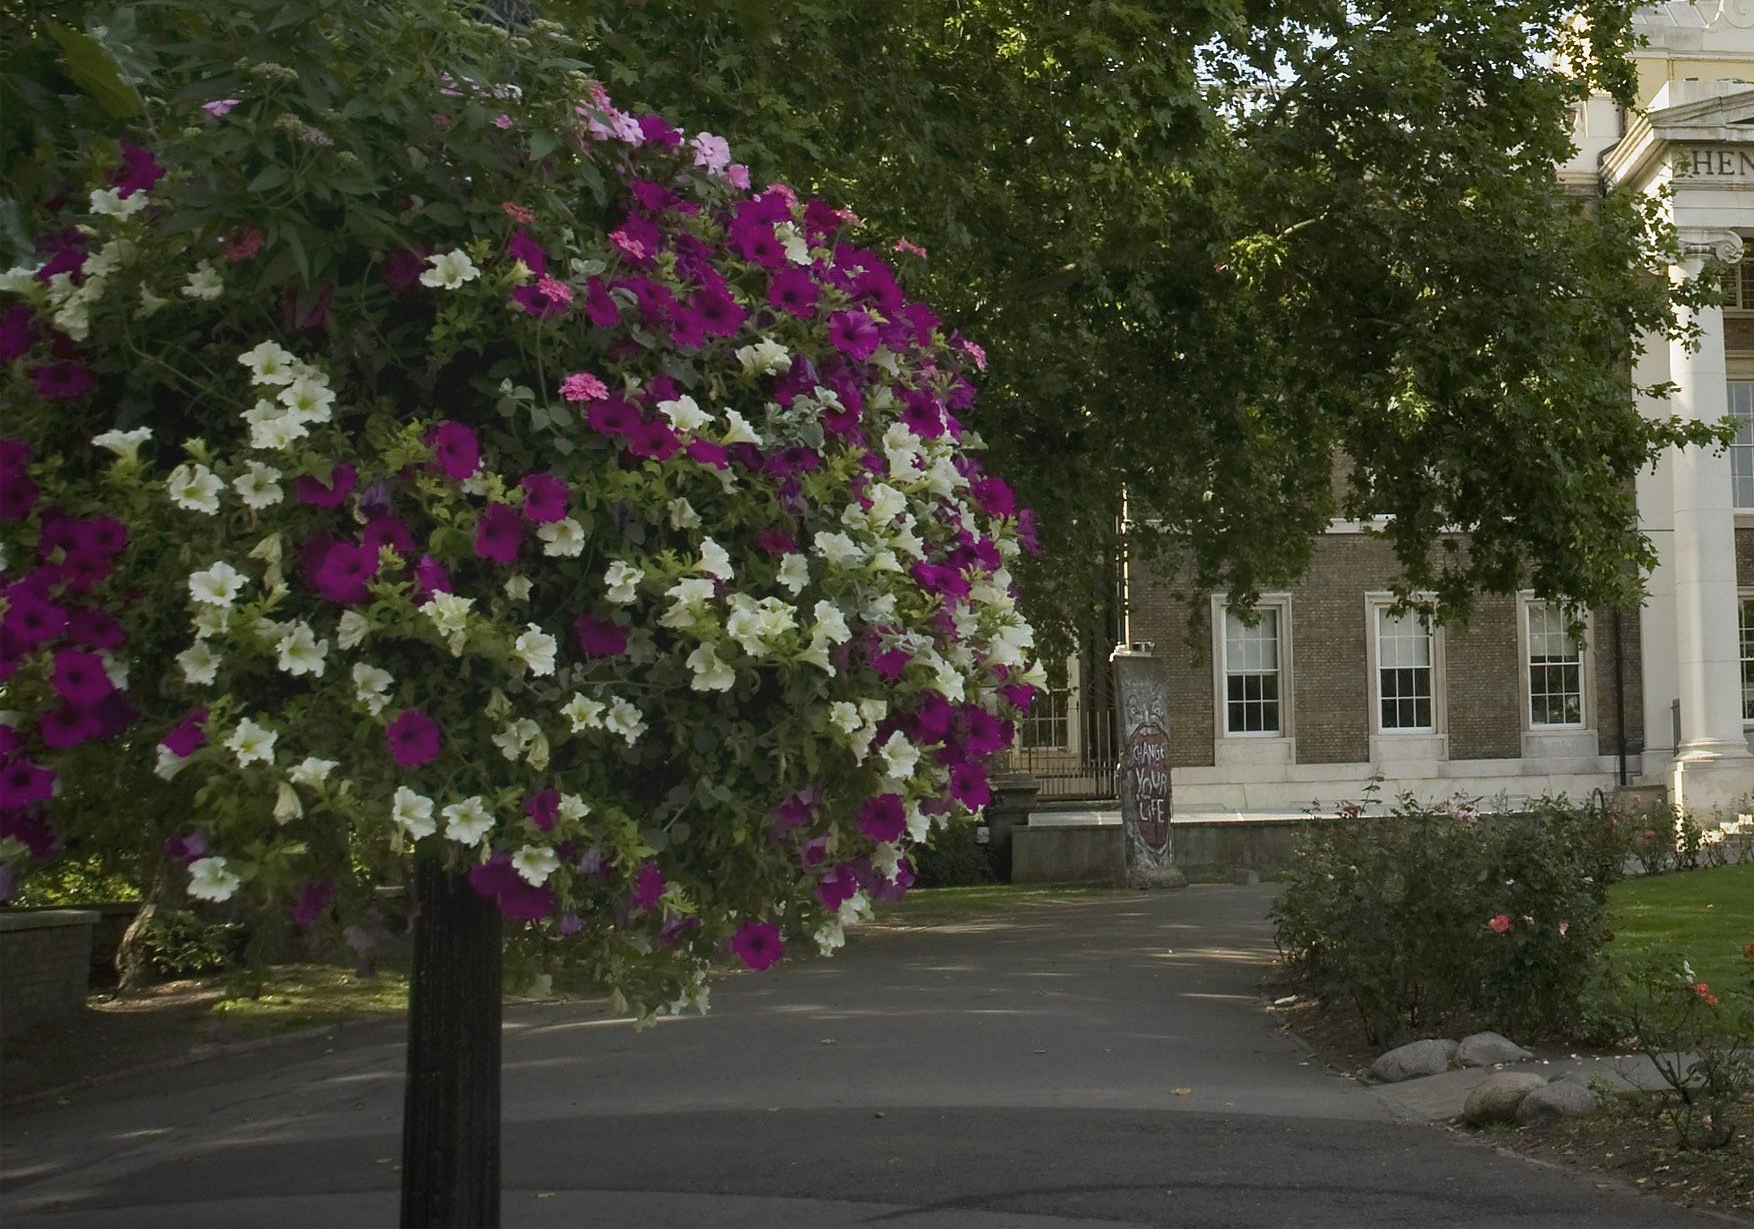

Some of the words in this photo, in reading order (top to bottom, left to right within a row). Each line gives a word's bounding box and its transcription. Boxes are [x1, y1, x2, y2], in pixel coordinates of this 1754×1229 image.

[1133, 741, 1165, 763] CHANGE
[1135, 767, 1167, 796] YOUR
[1140, 798, 1165, 823] LIFE
